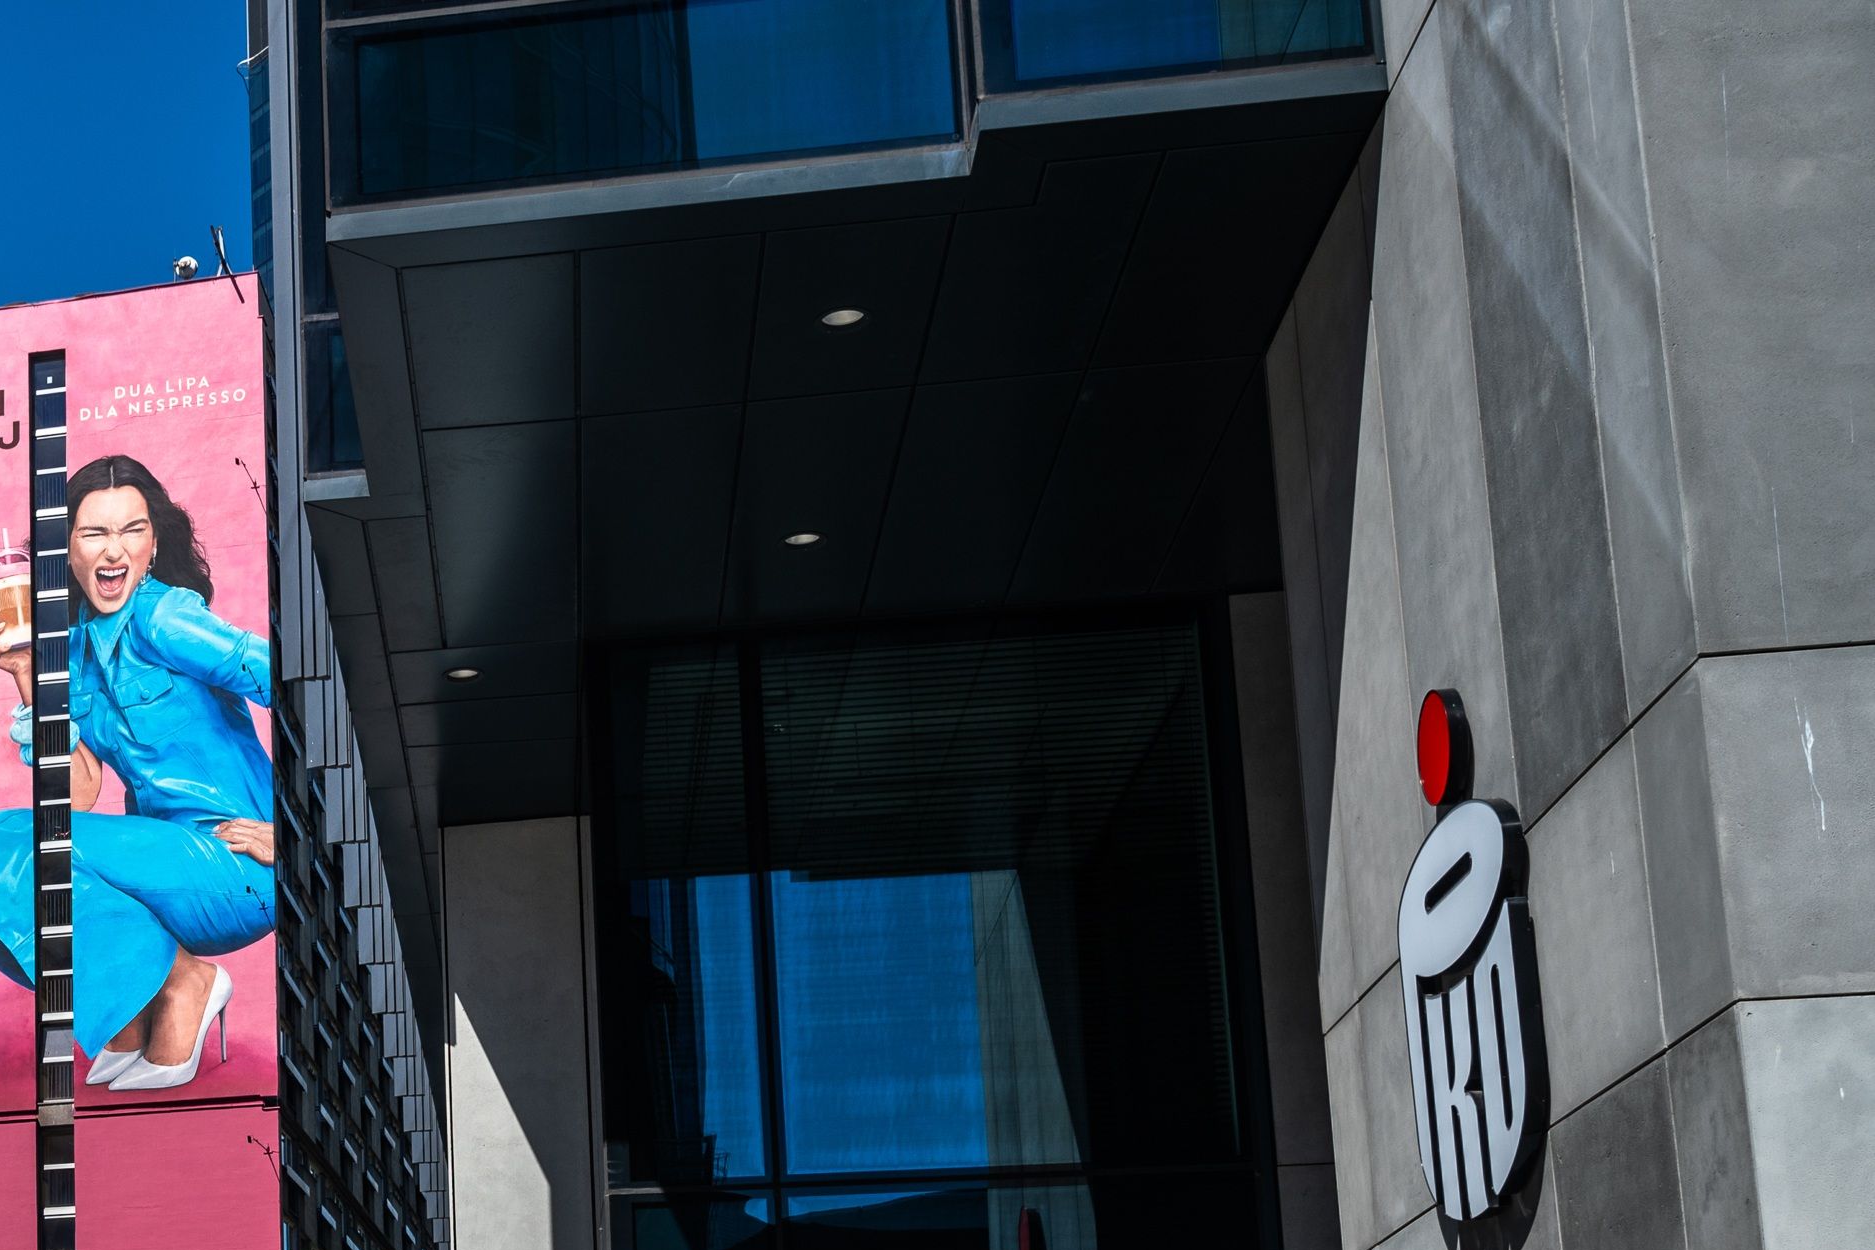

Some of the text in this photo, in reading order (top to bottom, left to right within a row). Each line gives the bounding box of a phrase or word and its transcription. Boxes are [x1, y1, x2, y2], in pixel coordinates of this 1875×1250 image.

[114, 376, 209, 400] DUA LIPA
[79, 388, 246, 421] DLA NESPRESSO
